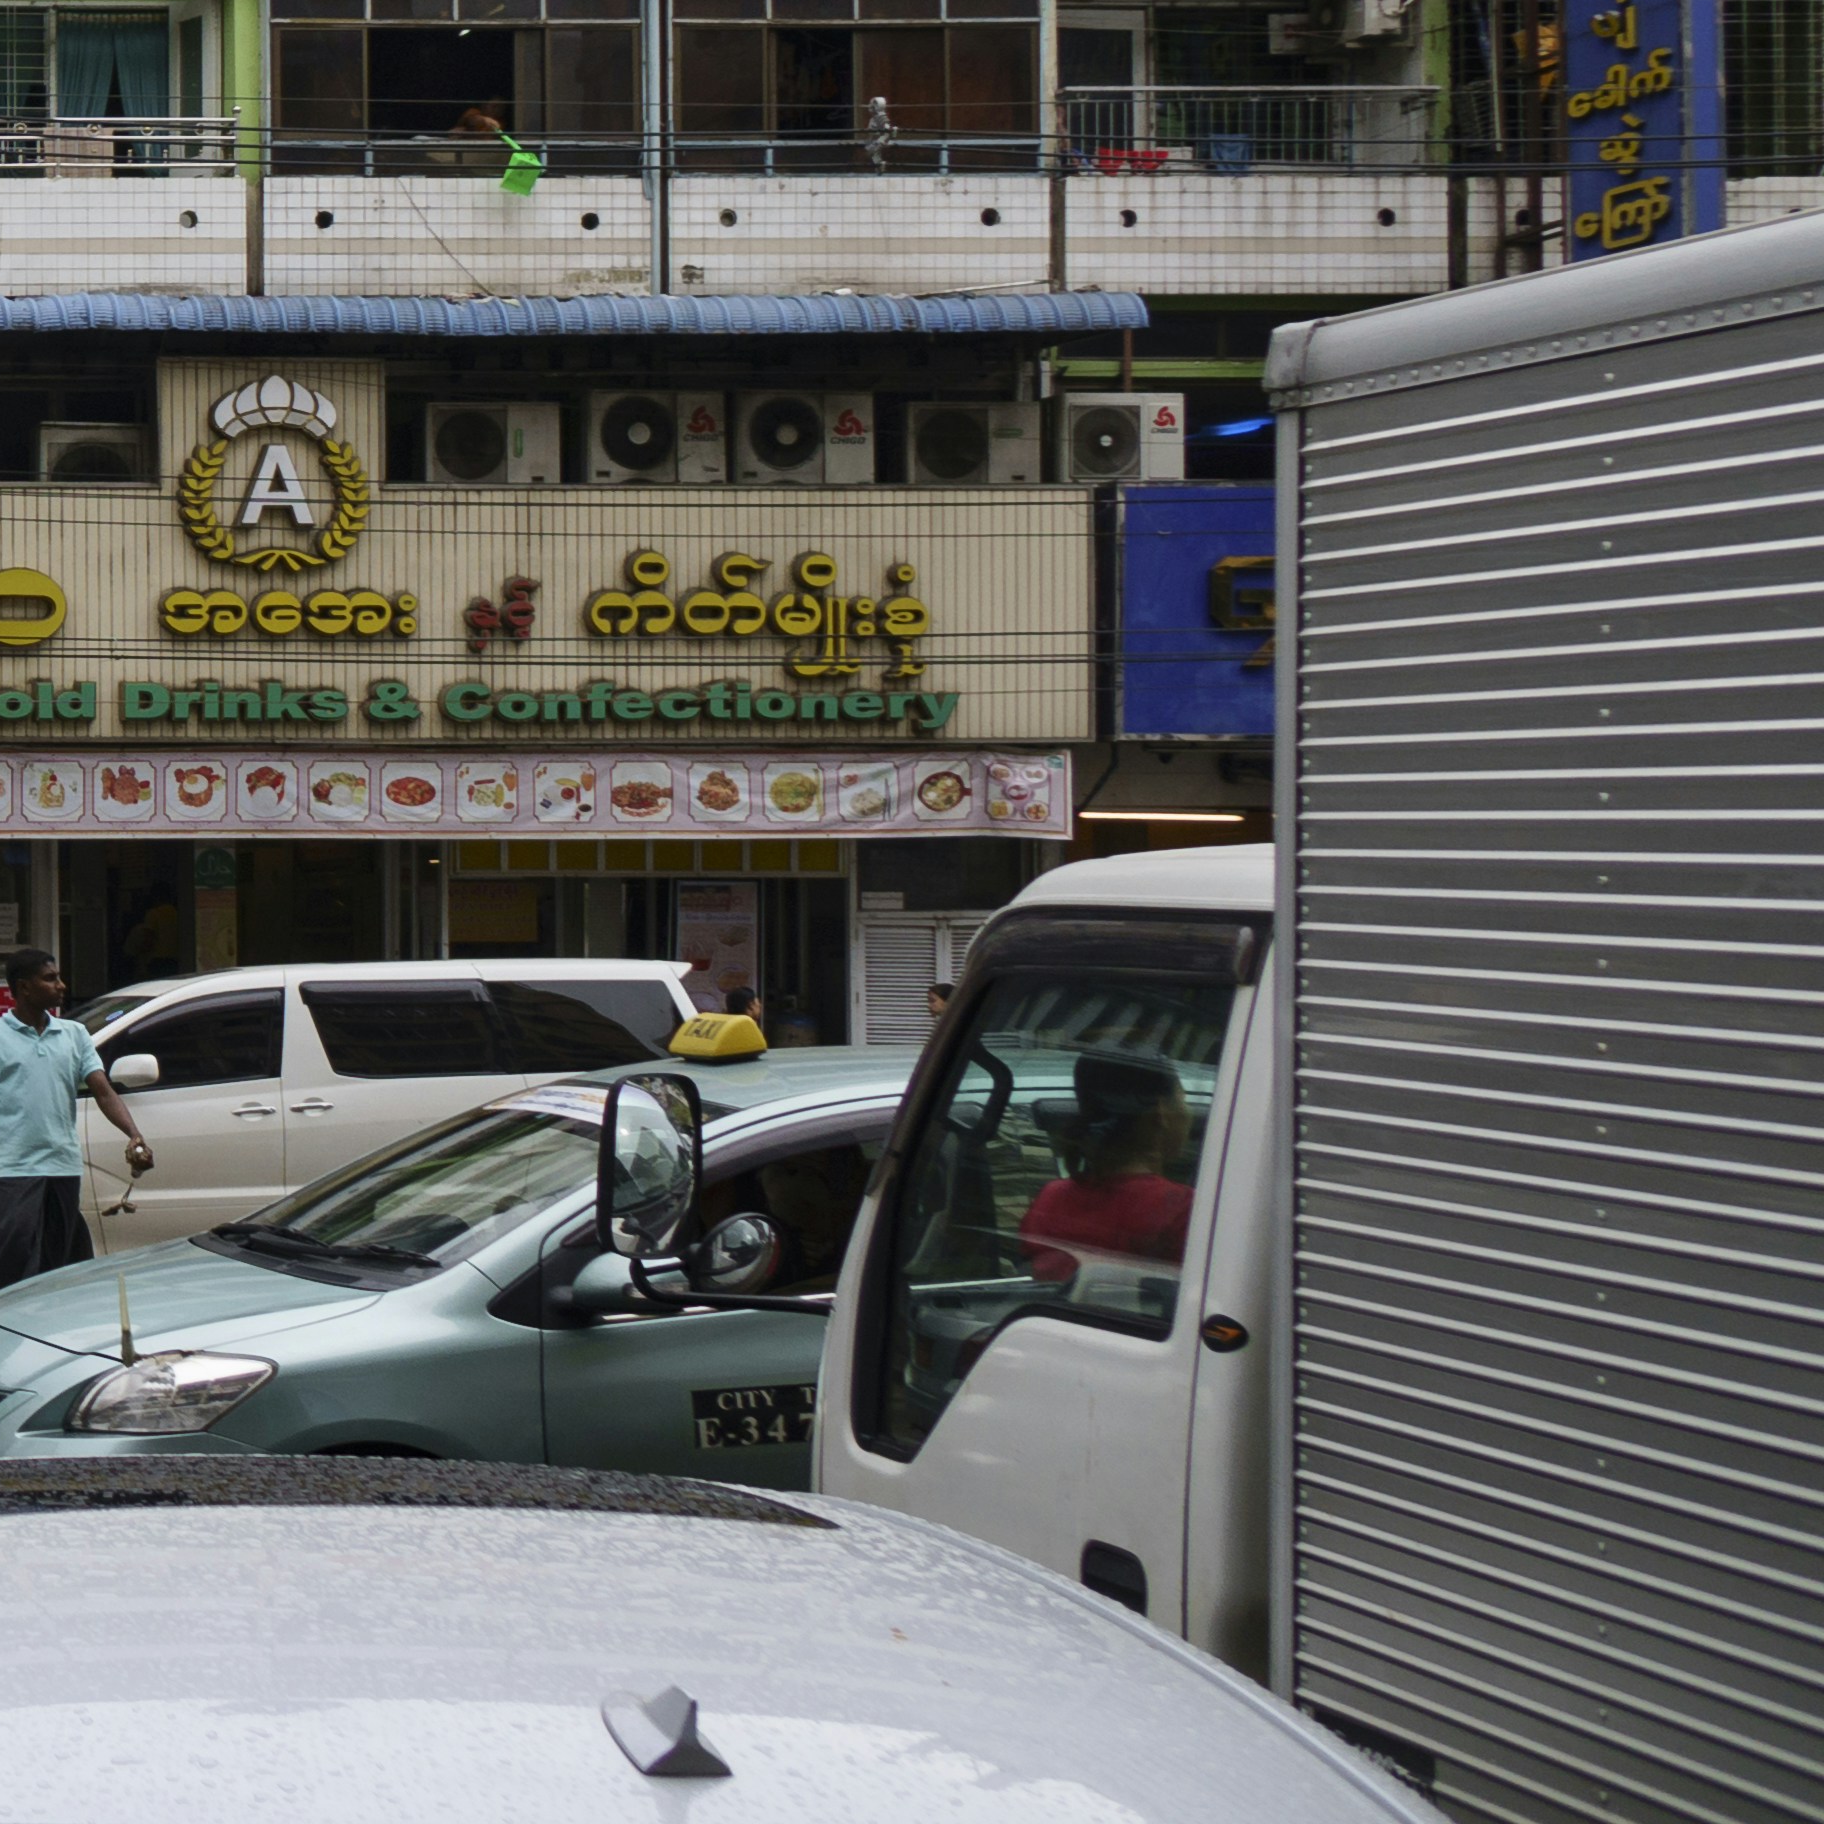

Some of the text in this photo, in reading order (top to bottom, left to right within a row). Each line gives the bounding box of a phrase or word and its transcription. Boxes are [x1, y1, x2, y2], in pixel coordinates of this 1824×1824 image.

[120, 679, 347, 722] Drinks
[368, 682, 420, 722] &
[442, 681, 960, 731] Confectionery
[717, 1389, 776, 1410] CITY
